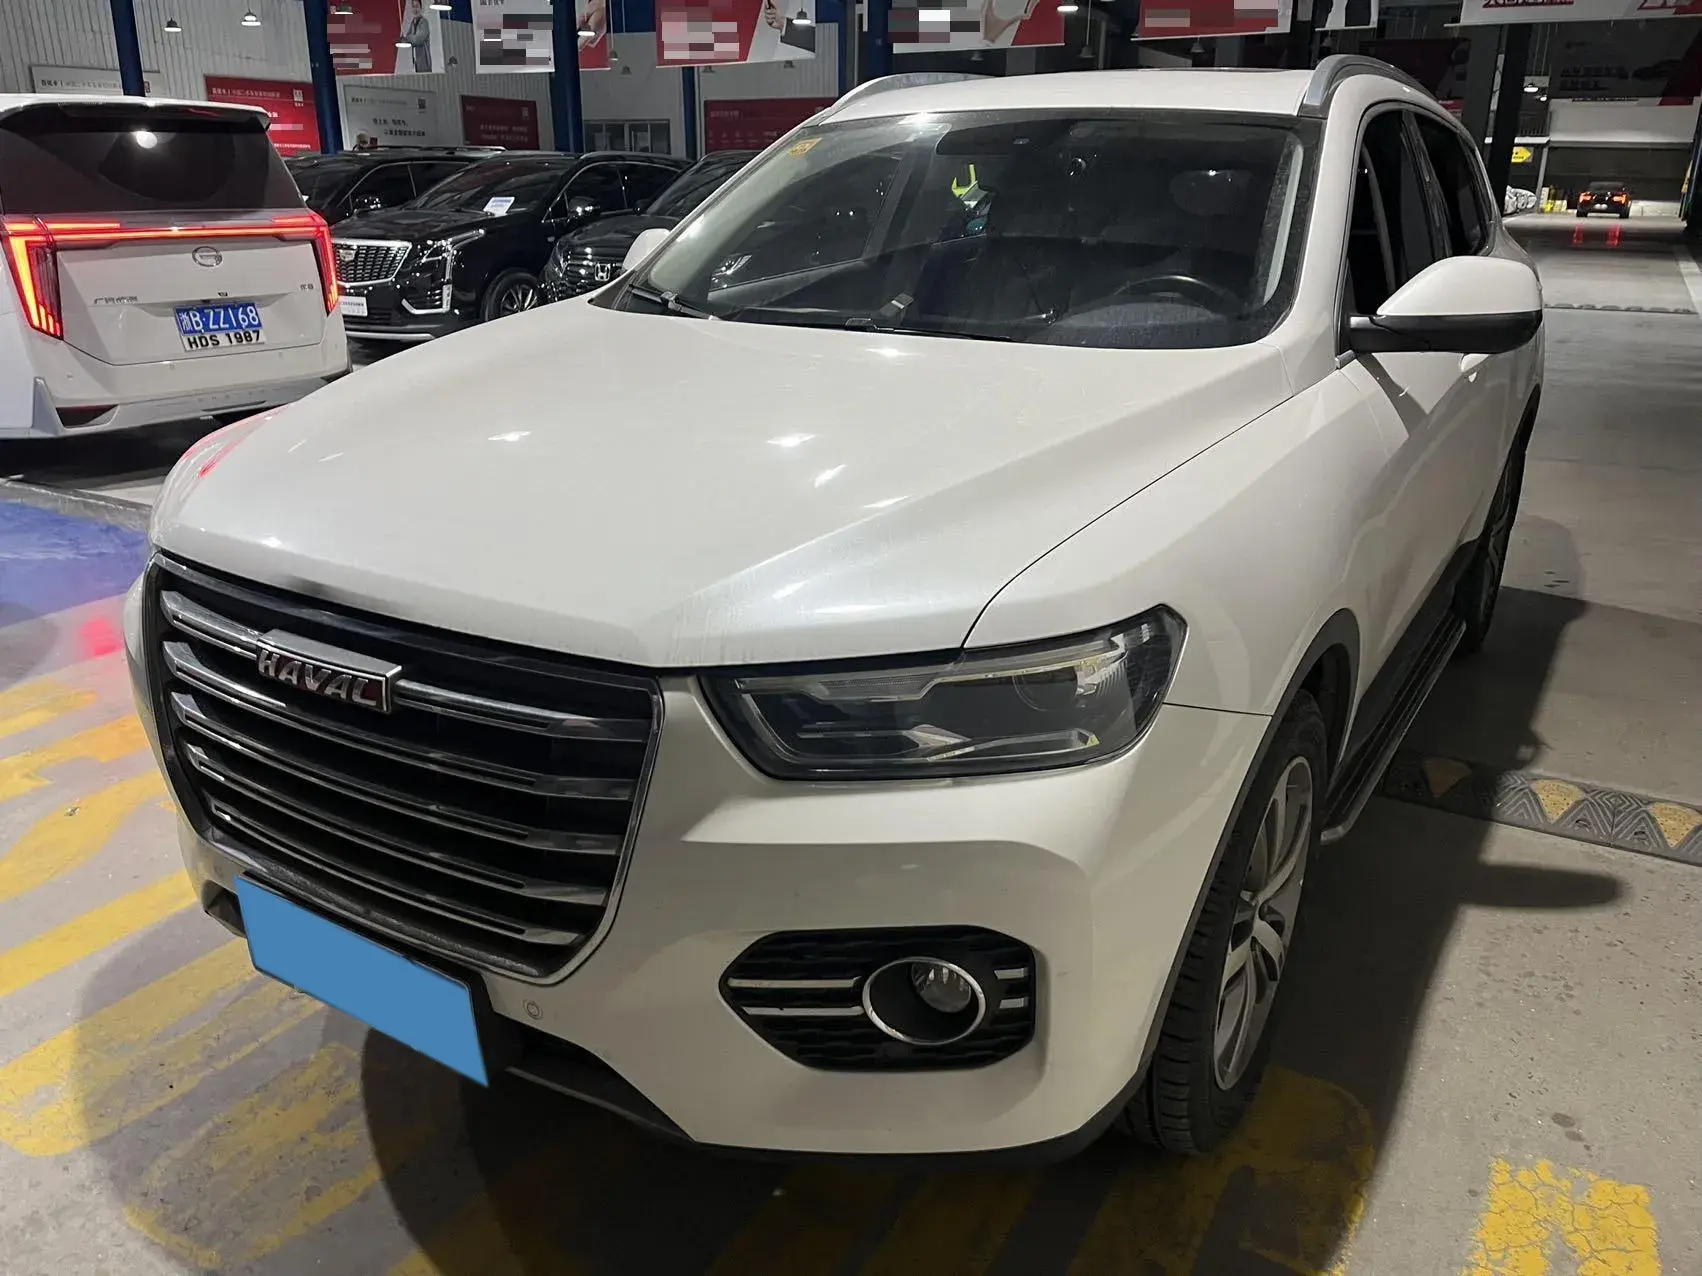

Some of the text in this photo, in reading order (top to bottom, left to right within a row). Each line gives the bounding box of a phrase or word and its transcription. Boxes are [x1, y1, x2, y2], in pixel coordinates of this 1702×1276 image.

[187, 330, 260, 349] HDS 1987
[258, 649, 377, 706] HAVAL
